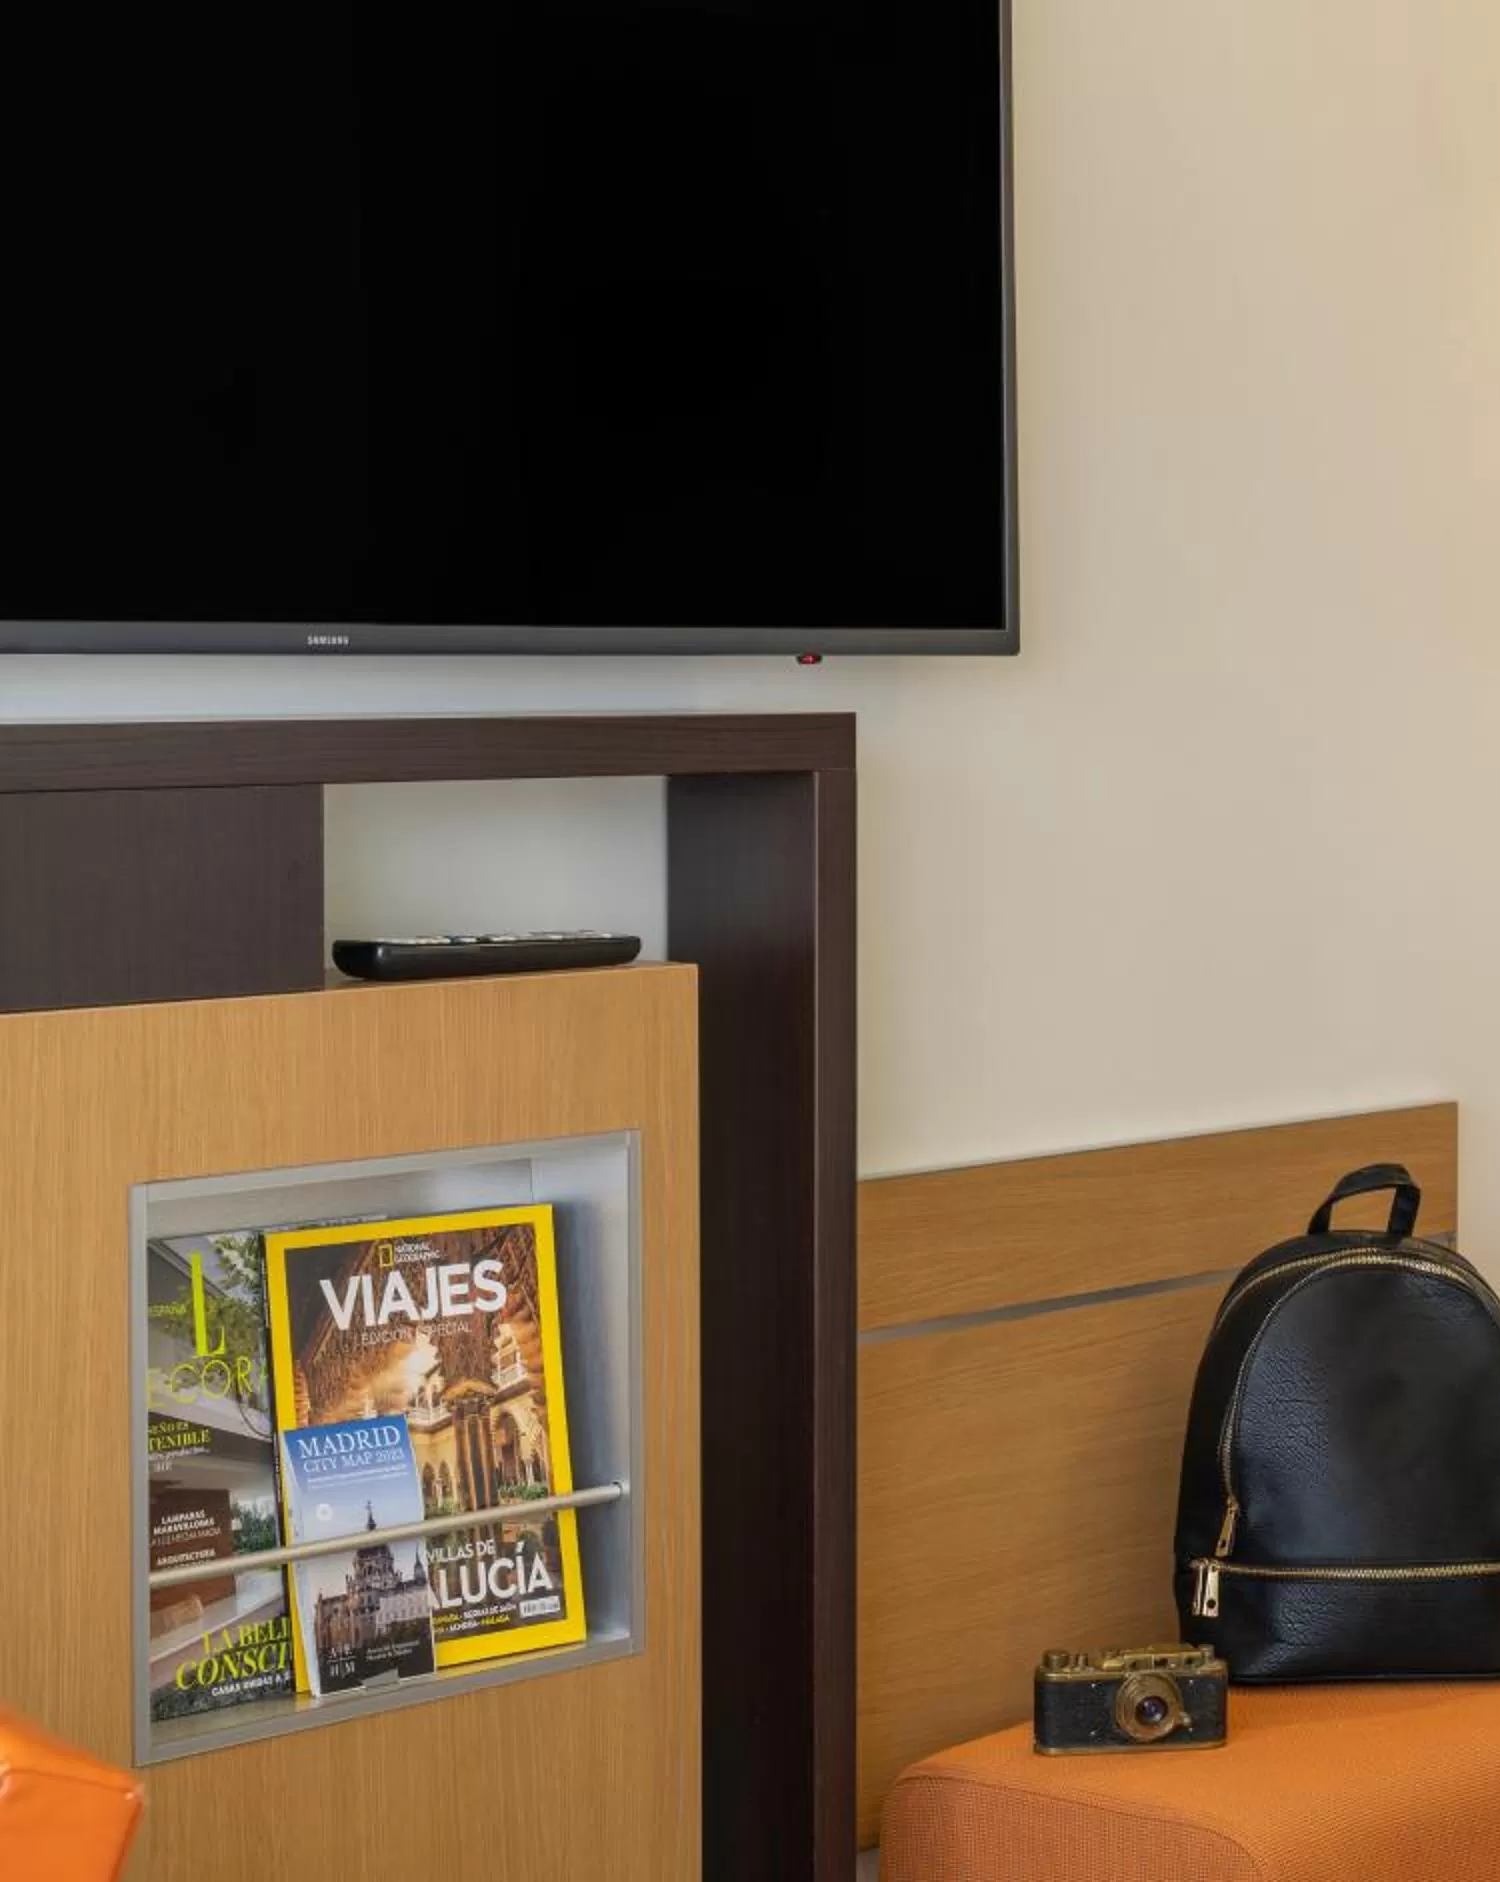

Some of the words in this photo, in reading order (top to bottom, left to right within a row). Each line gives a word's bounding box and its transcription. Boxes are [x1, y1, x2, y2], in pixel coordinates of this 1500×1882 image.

[307, 635, 349, 645] SAMSUNG
[319, 1258, 508, 1332] VIAJES
[296, 1424, 402, 1459] MADRID
[303, 1456, 337, 1473] CITY
[341, 1450, 373, 1468] MAP
[477, 1538, 497, 1557] DE
